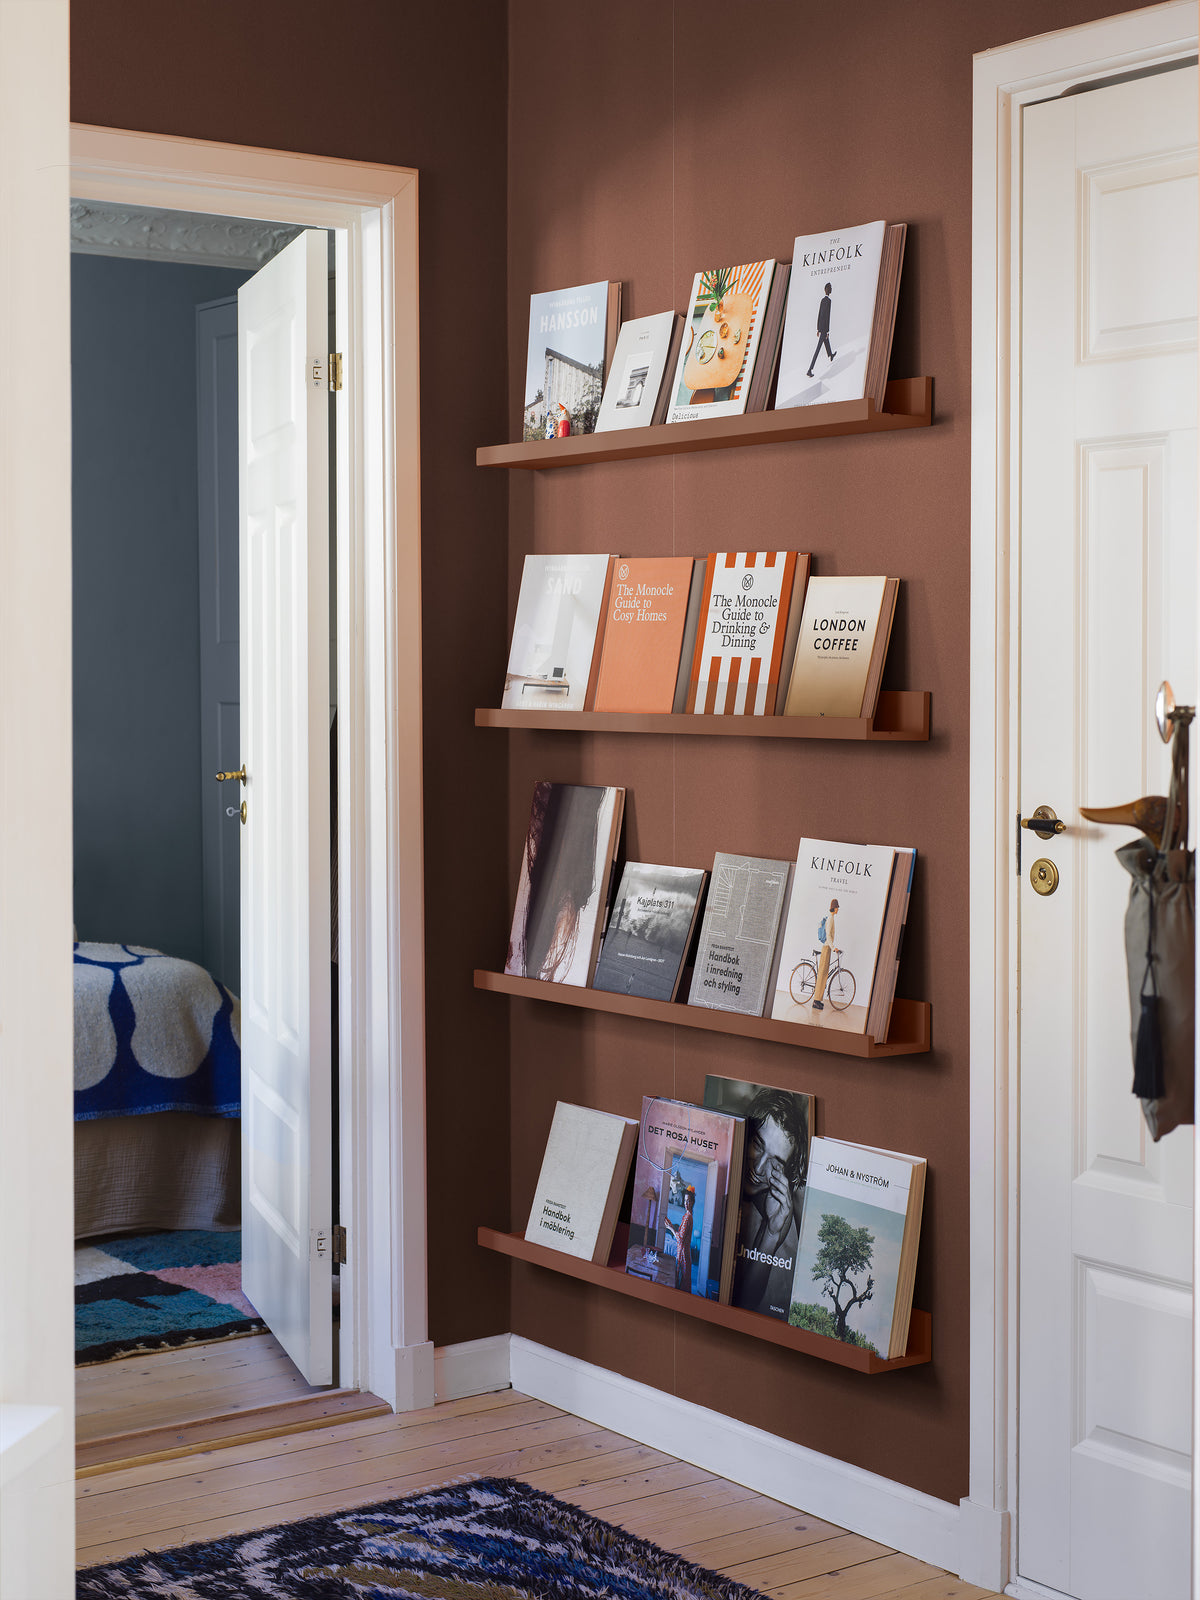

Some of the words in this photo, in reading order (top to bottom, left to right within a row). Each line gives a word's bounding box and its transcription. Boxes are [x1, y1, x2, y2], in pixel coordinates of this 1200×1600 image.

[802, 244, 862, 266] KINFOLK
[810, 264, 850, 276] ENTREPRENEUR
[540, 306, 598, 333] HANSSON
[546, 576, 582, 594] SAND
[616, 584, 634, 596] The
[636, 584, 674, 596] Monocle
[615, 596, 640, 608] Guide
[643, 599, 652, 608] to
[713, 594, 732, 606] The
[735, 594, 778, 608] Monocle
[614, 608, 634, 624] Cosy
[636, 609, 667, 621] Homes
[722, 608, 752, 620] Guide
[754, 611, 764, 620] to
[712, 621, 756, 637] Drinking
[760, 622, 770, 634] &
[814, 619, 866, 631] LONDON
[722, 634, 756, 650] Dining
[814, 638, 858, 650] COFFEE
[810, 856, 872, 877] KINFOLK
[637, 896, 662, 908] Kajplats
[664, 900, 674, 908] 311
[709, 950, 740, 966] Handbok
[706, 963, 710, 973] i
[710, 964, 742, 982] inredning
[704, 978, 716, 988] och
[718, 980, 740, 996] styling
[648, 1126, 664, 1136] DET
[666, 1130, 688, 1143] ROSA
[690, 1136, 718, 1150] HUSET
[826, 1164, 848, 1176] JOHAN
[850, 1170, 855, 1178] &
[856, 1172, 890, 1188] NYSTRÖM
[543, 1206, 572, 1224] Handbok
[540, 1217, 544, 1227] i
[543, 1220, 574, 1240] möblering
